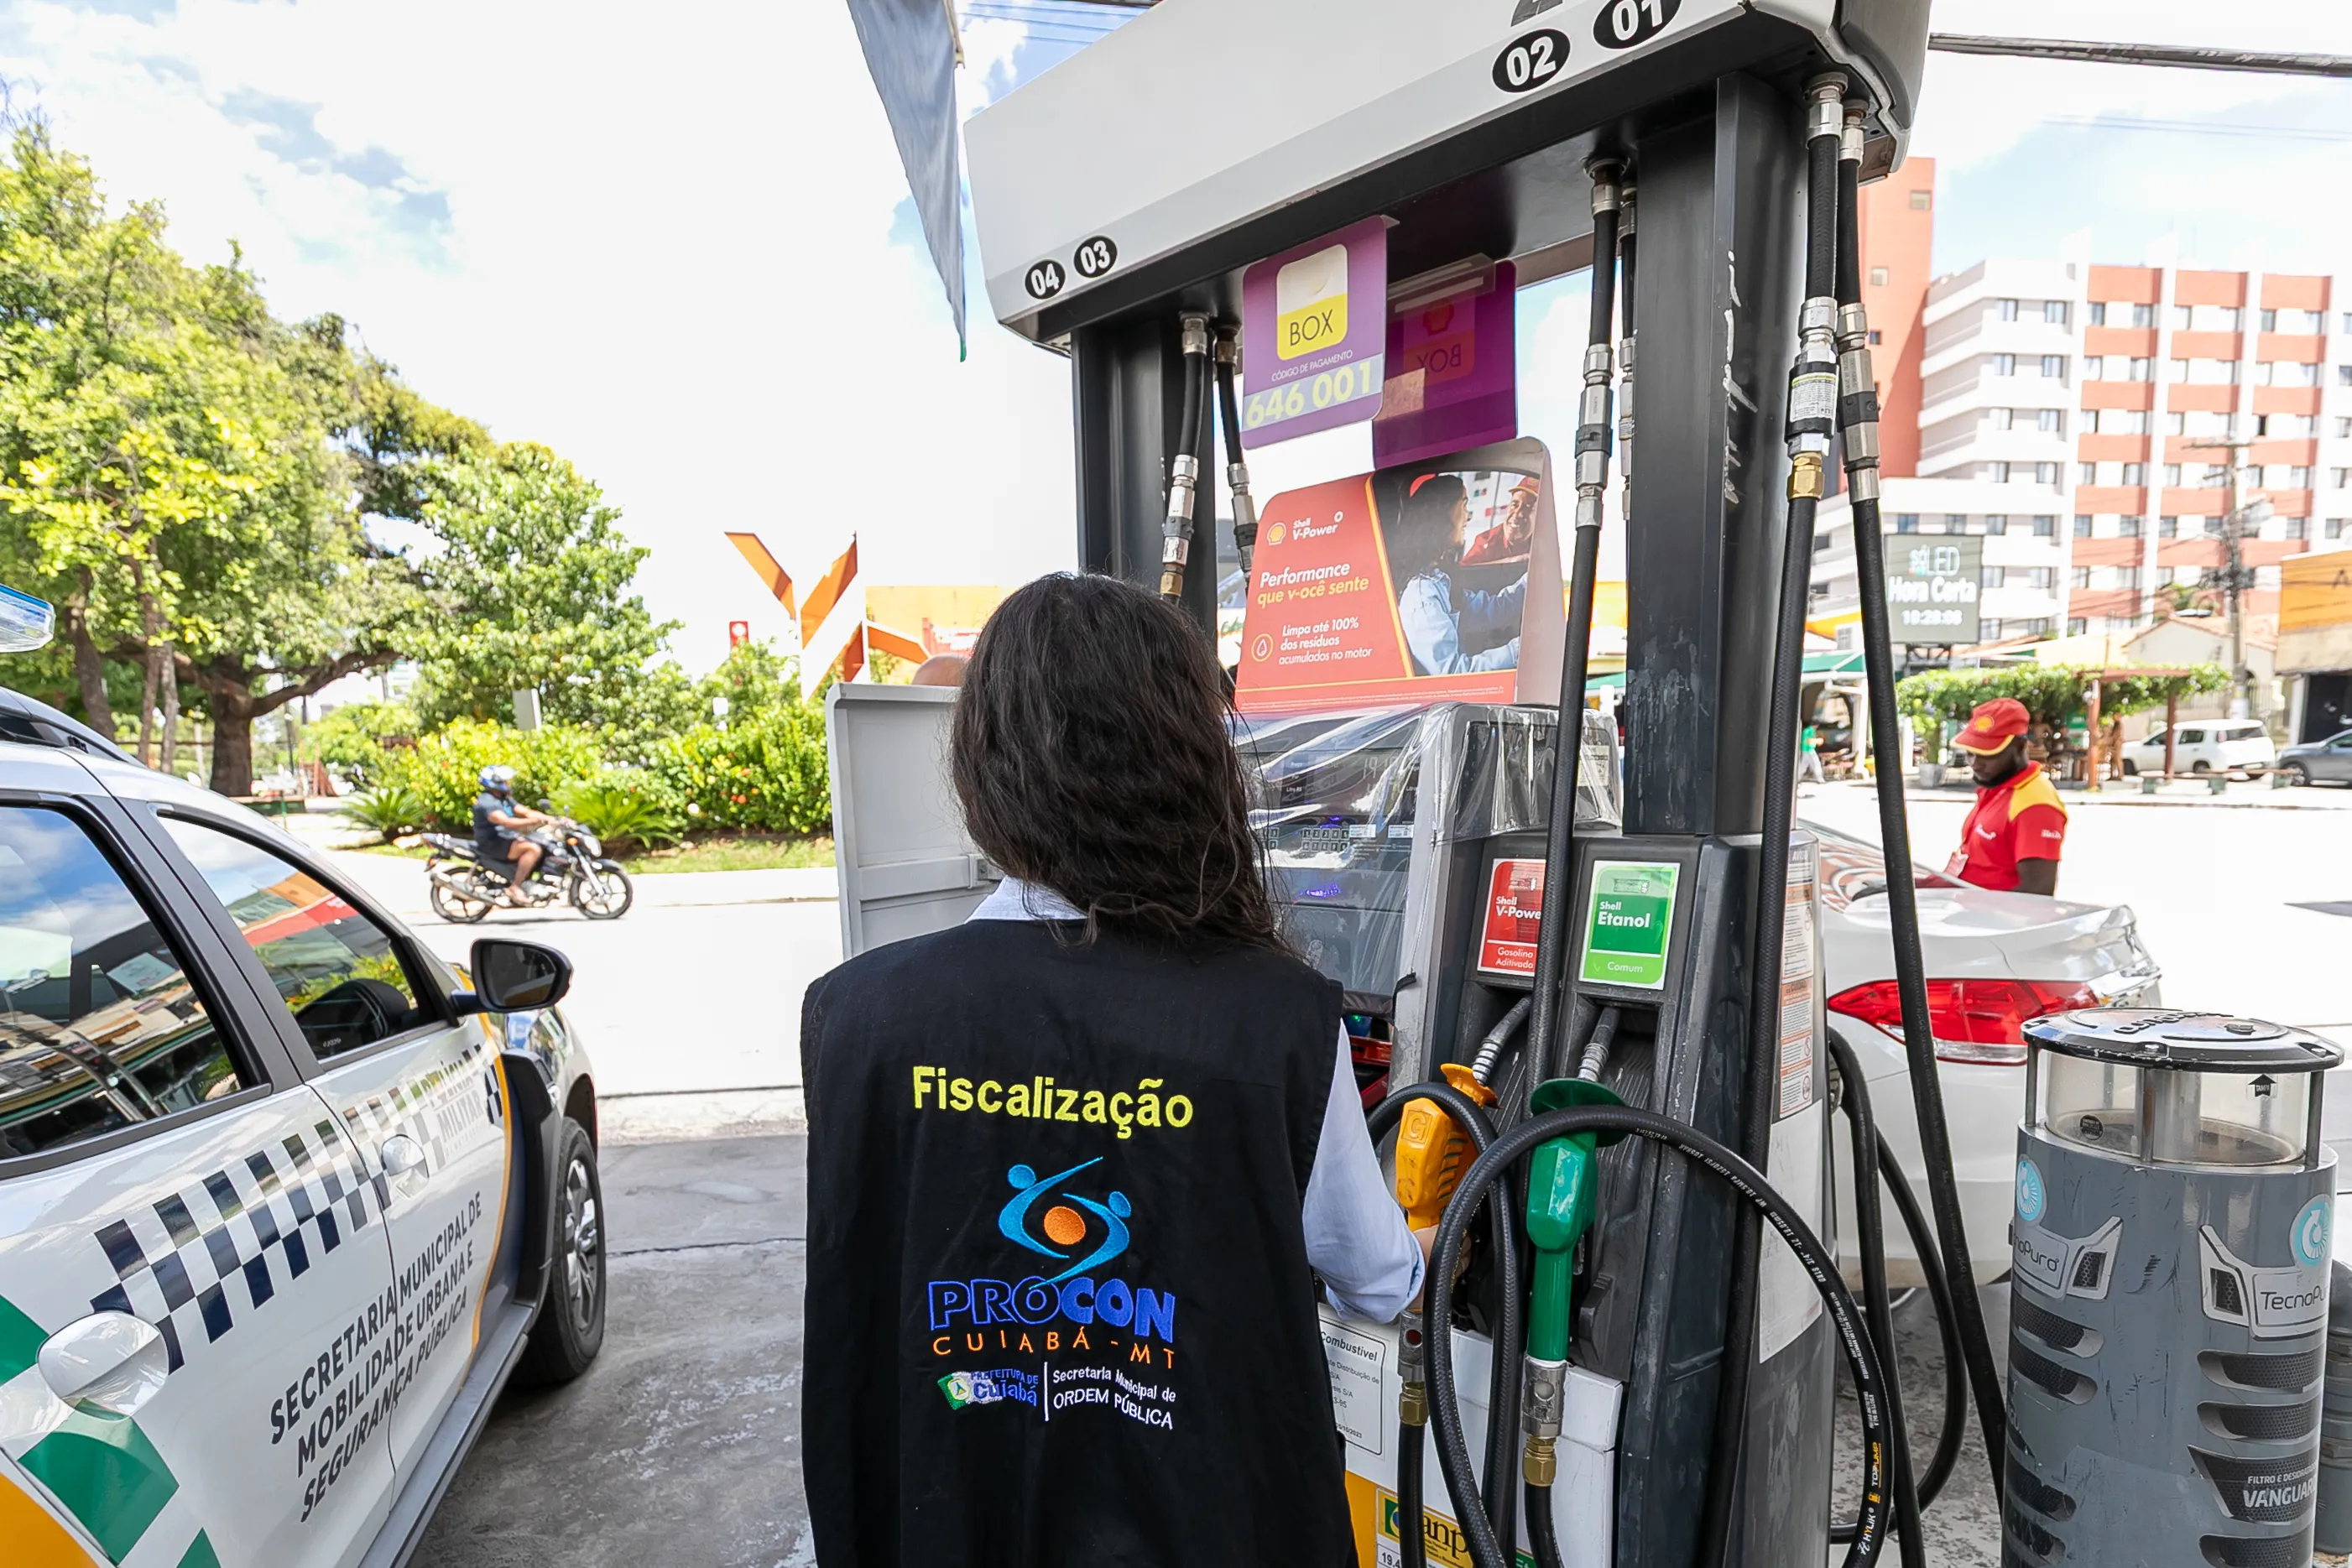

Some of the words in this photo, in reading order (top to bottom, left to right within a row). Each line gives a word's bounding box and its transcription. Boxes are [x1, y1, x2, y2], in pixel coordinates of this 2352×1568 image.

[1612, 0, 1663, 41] 01
[1506, 36, 1557, 86] 02
[1080, 240, 1110, 274] 03
[1030, 263, 1059, 296] 04
[1290, 309, 1333, 346] BOX
[1271, 366, 1299, 382] CÓDIGO
[1301, 362, 1310, 373] DE
[1310, 349, 1353, 372] PAGAMENTO
[1246, 383, 1305, 428] 646
[1312, 361, 1371, 409] 001
[1292, 524, 1338, 540] V-Power
[1293, 518, 1312, 529] Shell
[1259, 563, 1350, 588] Performance
[1257, 590, 1284, 608] que
[1288, 580, 1326, 601] v-ocê
[1328, 576, 1369, 595] sente
[1282, 624, 1311, 638] Limpa
[1312, 620, 1329, 633] até
[1332, 617, 1359, 632] 100%
[1279, 650, 1329, 664] acumulados
[1332, 650, 1343, 660] no
[1344, 647, 1373, 659] motor
[1280, 638, 1297, 651] dos
[1299, 635, 1340, 649] resíduos
[1495, 896, 1517, 905] Shell
[1495, 906, 1541, 919] V-Powe
[1599, 901, 1621, 910] Shell
[1598, 911, 1651, 928] Etanol
[1495, 958, 1534, 969] Aditivada
[1497, 947, 1534, 958] Gasolina
[1607, 961, 1643, 973] Comum
[436, 1089, 484, 1143] MILITAR
[912, 1065, 1193, 1139] Fiscalização
[1410, 1112, 1426, 1141] G
[928, 1275, 1176, 1343] PROCON
[2260, 1284, 2325, 1310] TecnoPu
[270, 1284, 396, 1445] SECRETARIA
[399, 1210, 467, 1307] MUNICIPAL
[469, 1191, 482, 1227] DE
[298, 1310, 414, 1478] MOBILIDADE
[416, 1253, 465, 1332] URBANA
[467, 1240, 473, 1268] E
[932, 1326, 1090, 1356] CUIABÁ
[1129, 1343, 1175, 1369] MT
[970, 1367, 1025, 1383] PREFEITURA
[1027, 1374, 1038, 1384] DE
[1052, 1366, 1112, 1384] Secretaria
[1115, 1369, 1157, 1400] Municipal
[1161, 1387, 1176, 1403] de
[1337, 1362, 1371, 1382] Distribuição
[1371, 1376, 1379, 1384] de
[300, 1356, 413, 1523] SEGURANÇA
[415, 1286, 467, 1374] PÚBLICA
[973, 1379, 1037, 1407] Cuiabá
[1342, 1388, 1353, 1399] S/A
[1053, 1388, 1109, 1410] ORDEM
[1114, 1393, 1173, 1430] PÚBLICA
[2243, 1477, 2315, 1508] VANGUAR
[2247, 1475, 2276, 1484] FILTRO
[2276, 1474, 2282, 1482] E
[1863, 1513, 1876, 1542] HYLIK
